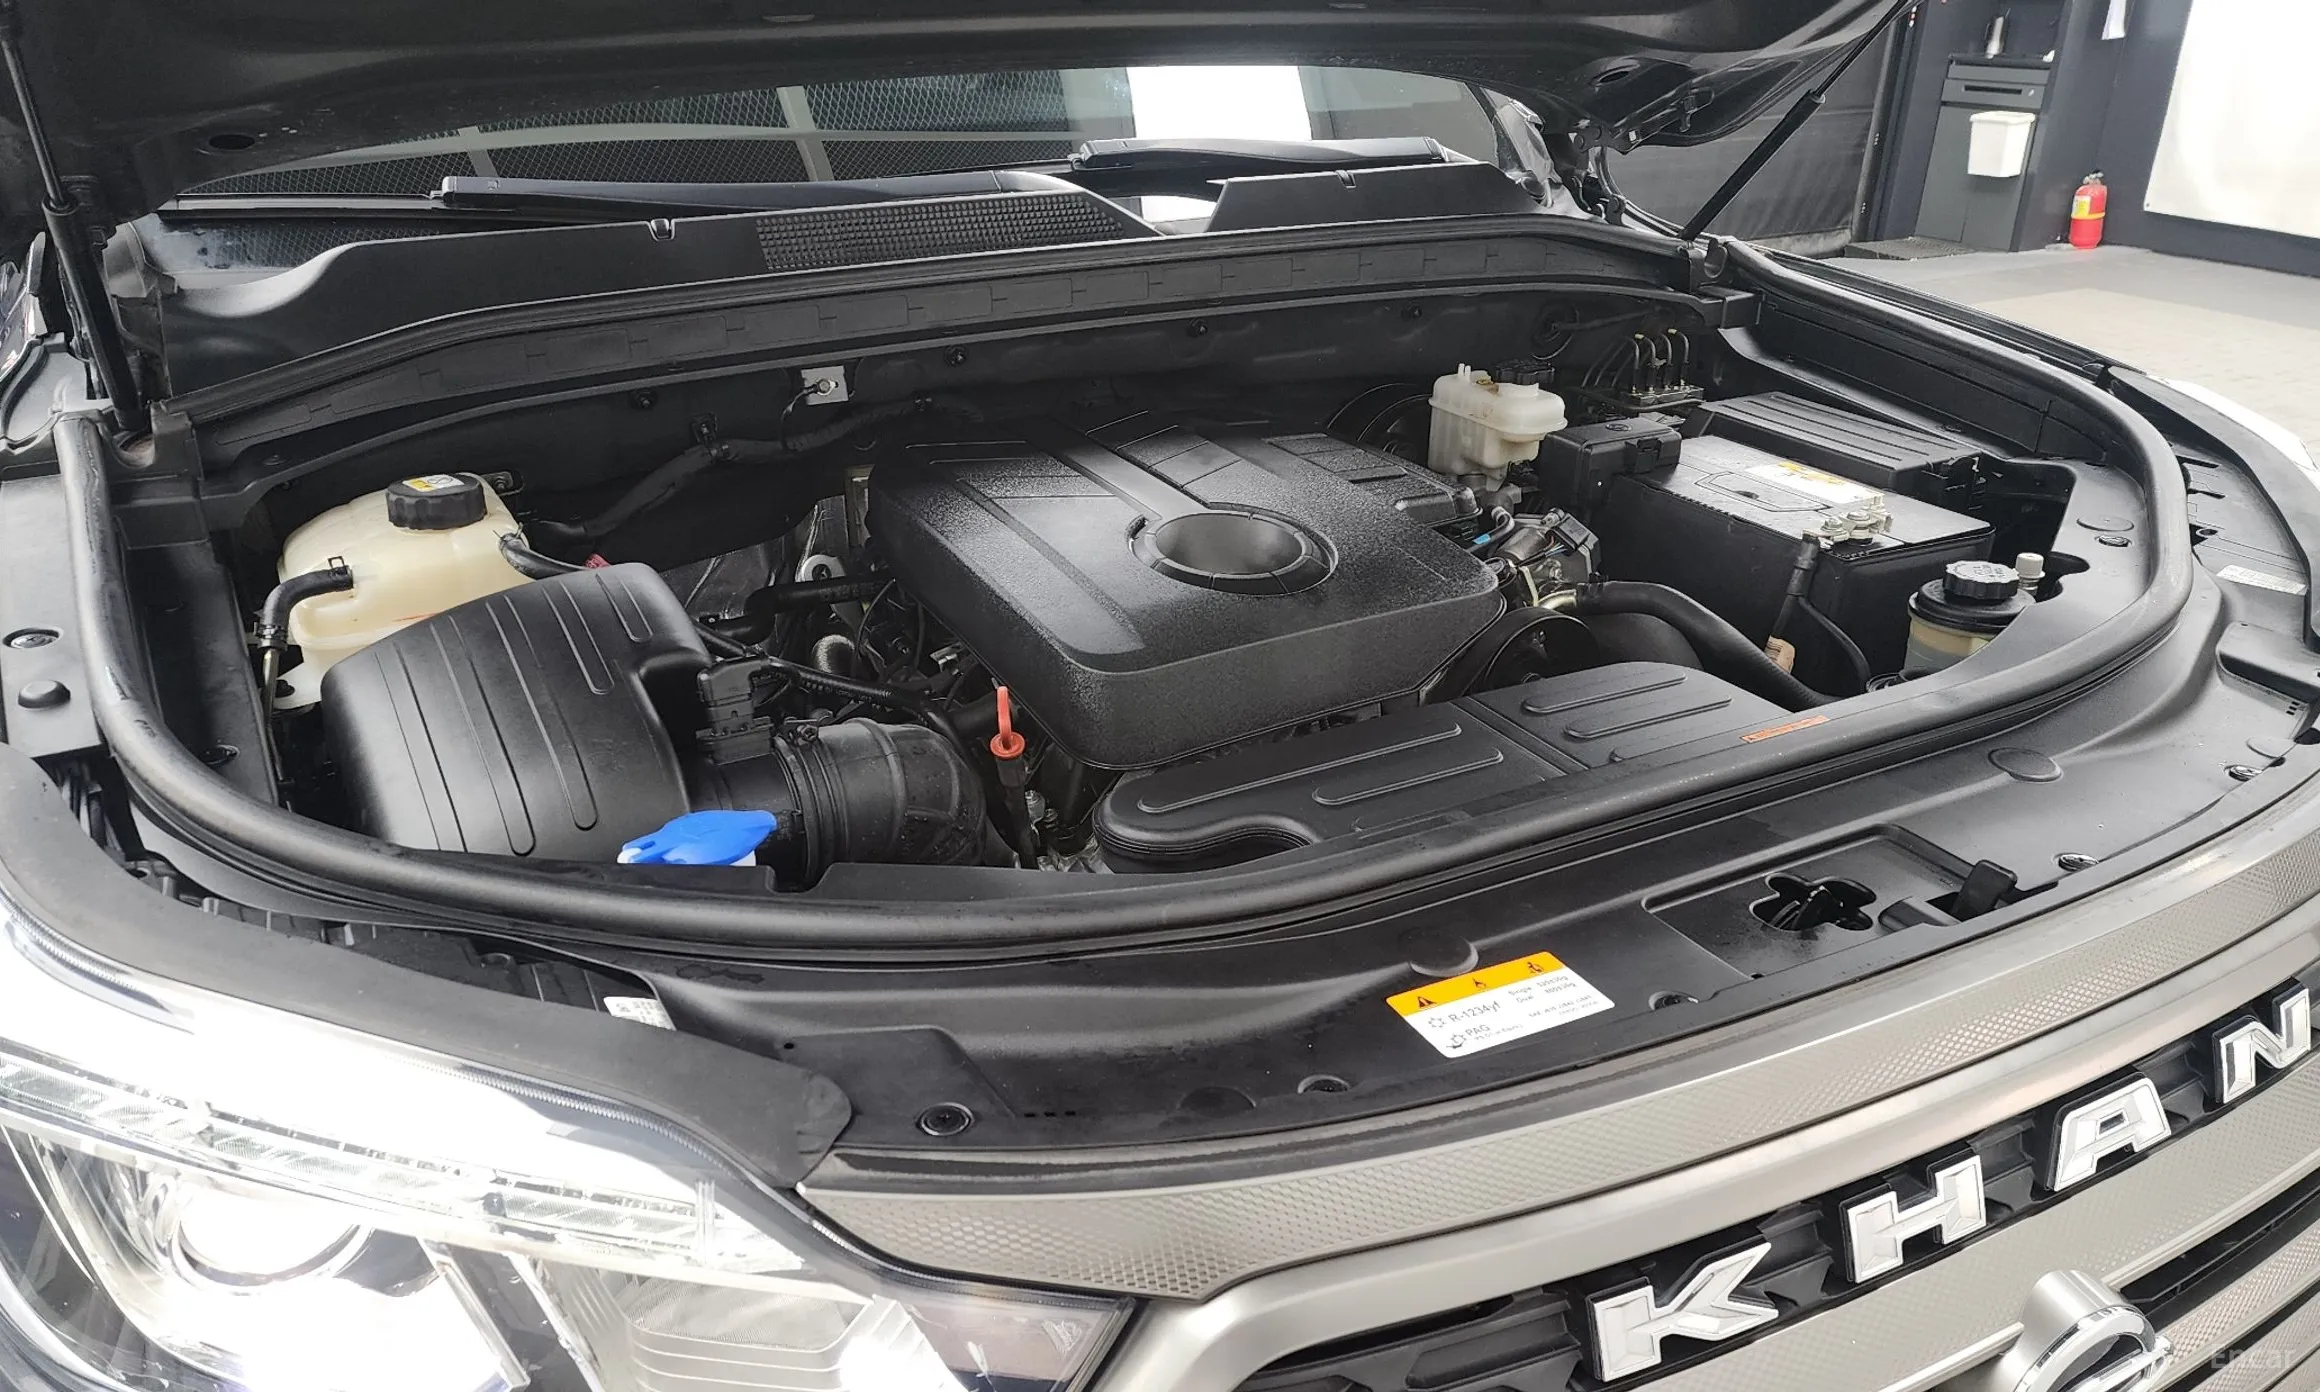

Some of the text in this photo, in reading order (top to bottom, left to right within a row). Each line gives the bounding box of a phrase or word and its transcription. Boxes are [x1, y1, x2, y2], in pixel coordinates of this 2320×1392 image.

[1448, 1000, 1502, 1023] R-1234yf
[1465, 1023, 1491, 1036] PAG
[1593, 986, 2312, 1383] KHAN
